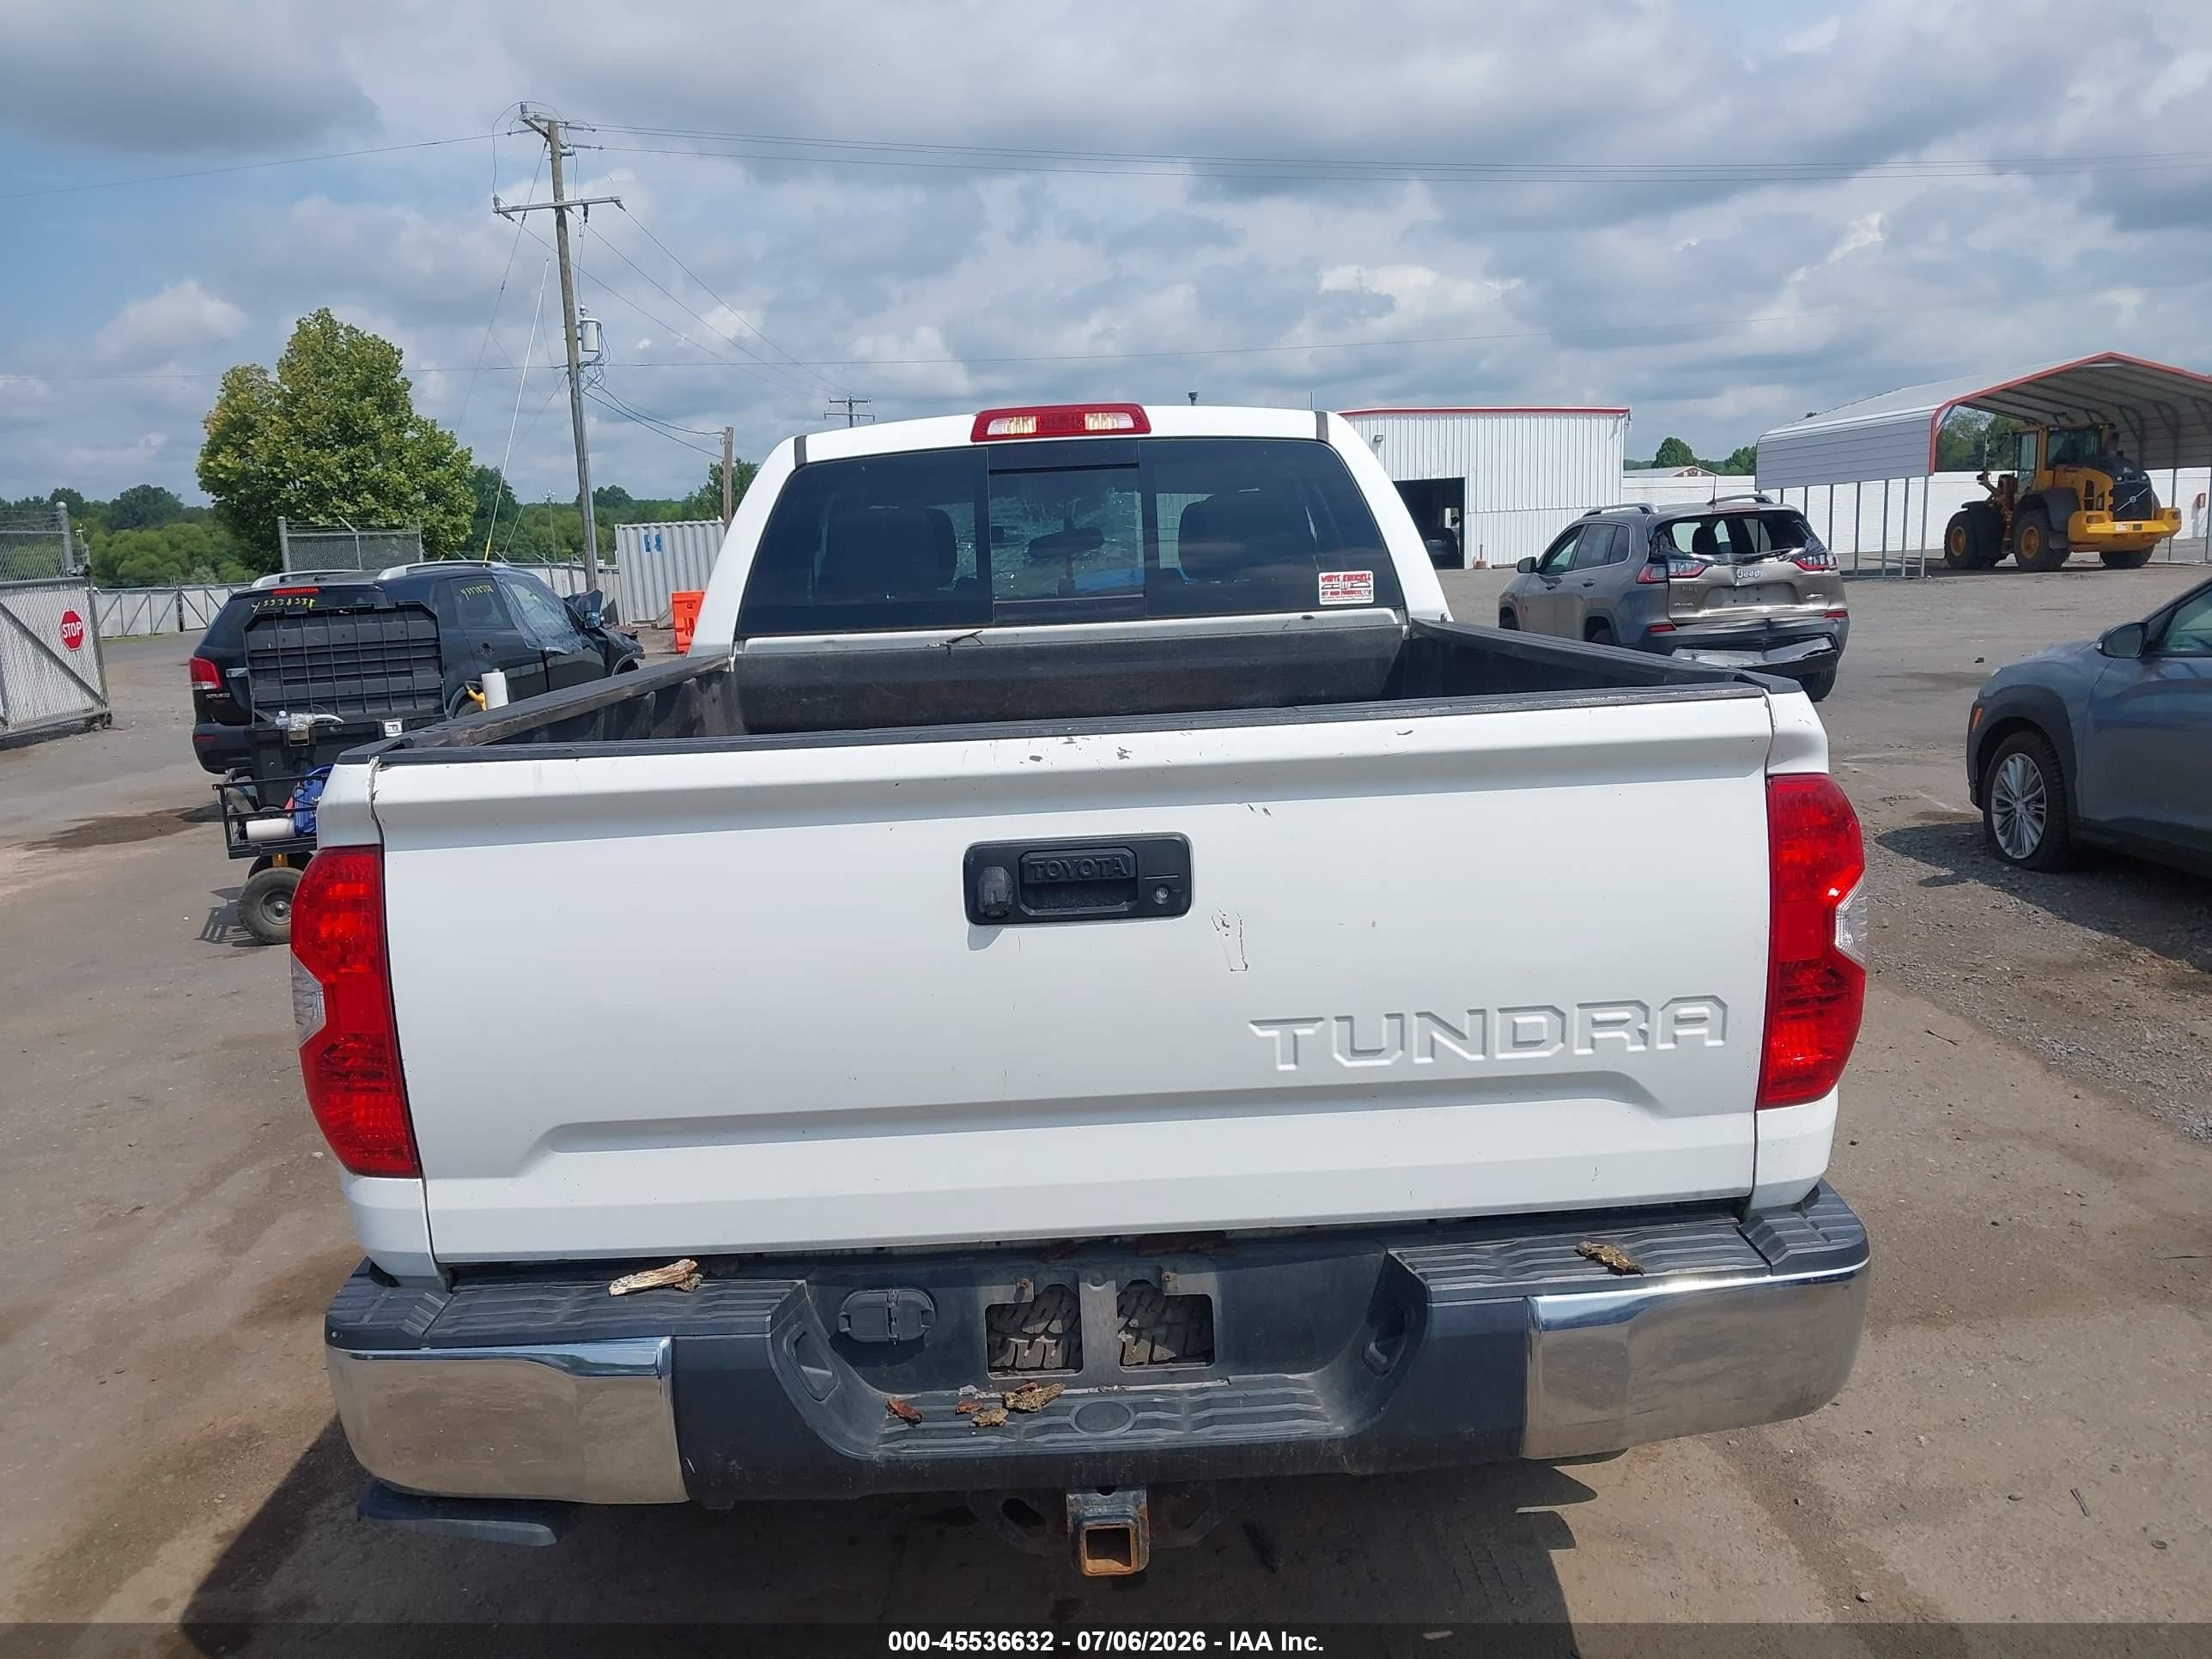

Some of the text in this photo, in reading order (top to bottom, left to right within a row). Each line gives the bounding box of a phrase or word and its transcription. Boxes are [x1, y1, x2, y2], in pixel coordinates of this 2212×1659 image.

[1736, 569, 1760, 579] Jeep
[62, 621, 82, 639] STOP
[1030, 857, 1127, 881] TOYOTA
[1249, 994, 1728, 1071] TUNDRA
